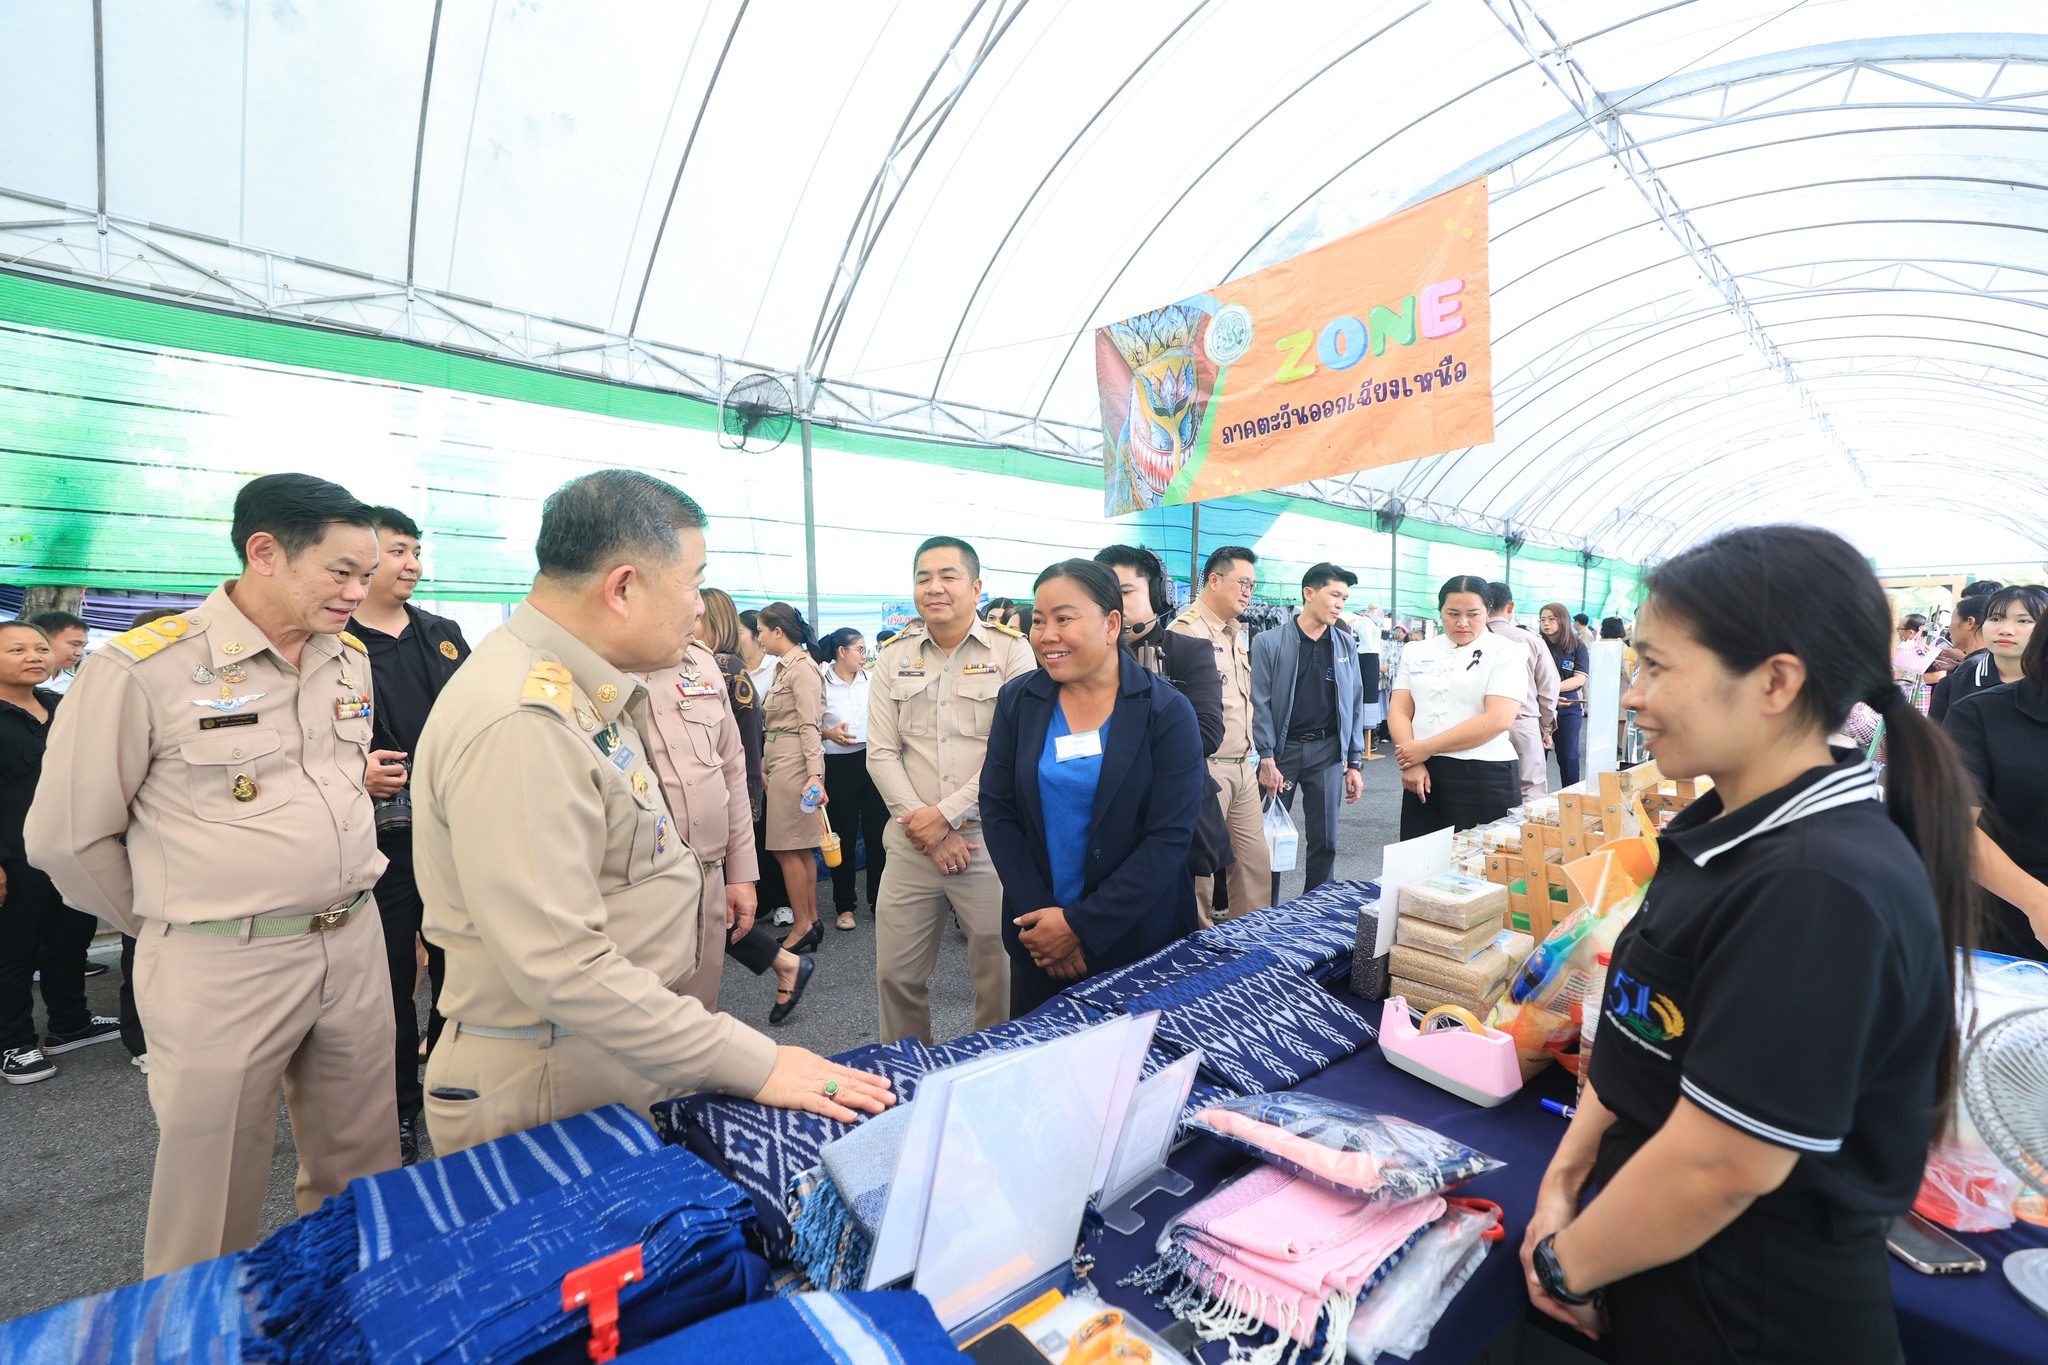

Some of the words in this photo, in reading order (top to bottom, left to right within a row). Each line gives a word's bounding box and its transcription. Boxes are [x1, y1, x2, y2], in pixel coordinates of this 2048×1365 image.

[1274, 278, 1467, 384] ZONE
[1222, 354, 1468, 445] ภาคตะวันออกเฉียงเหนือ
